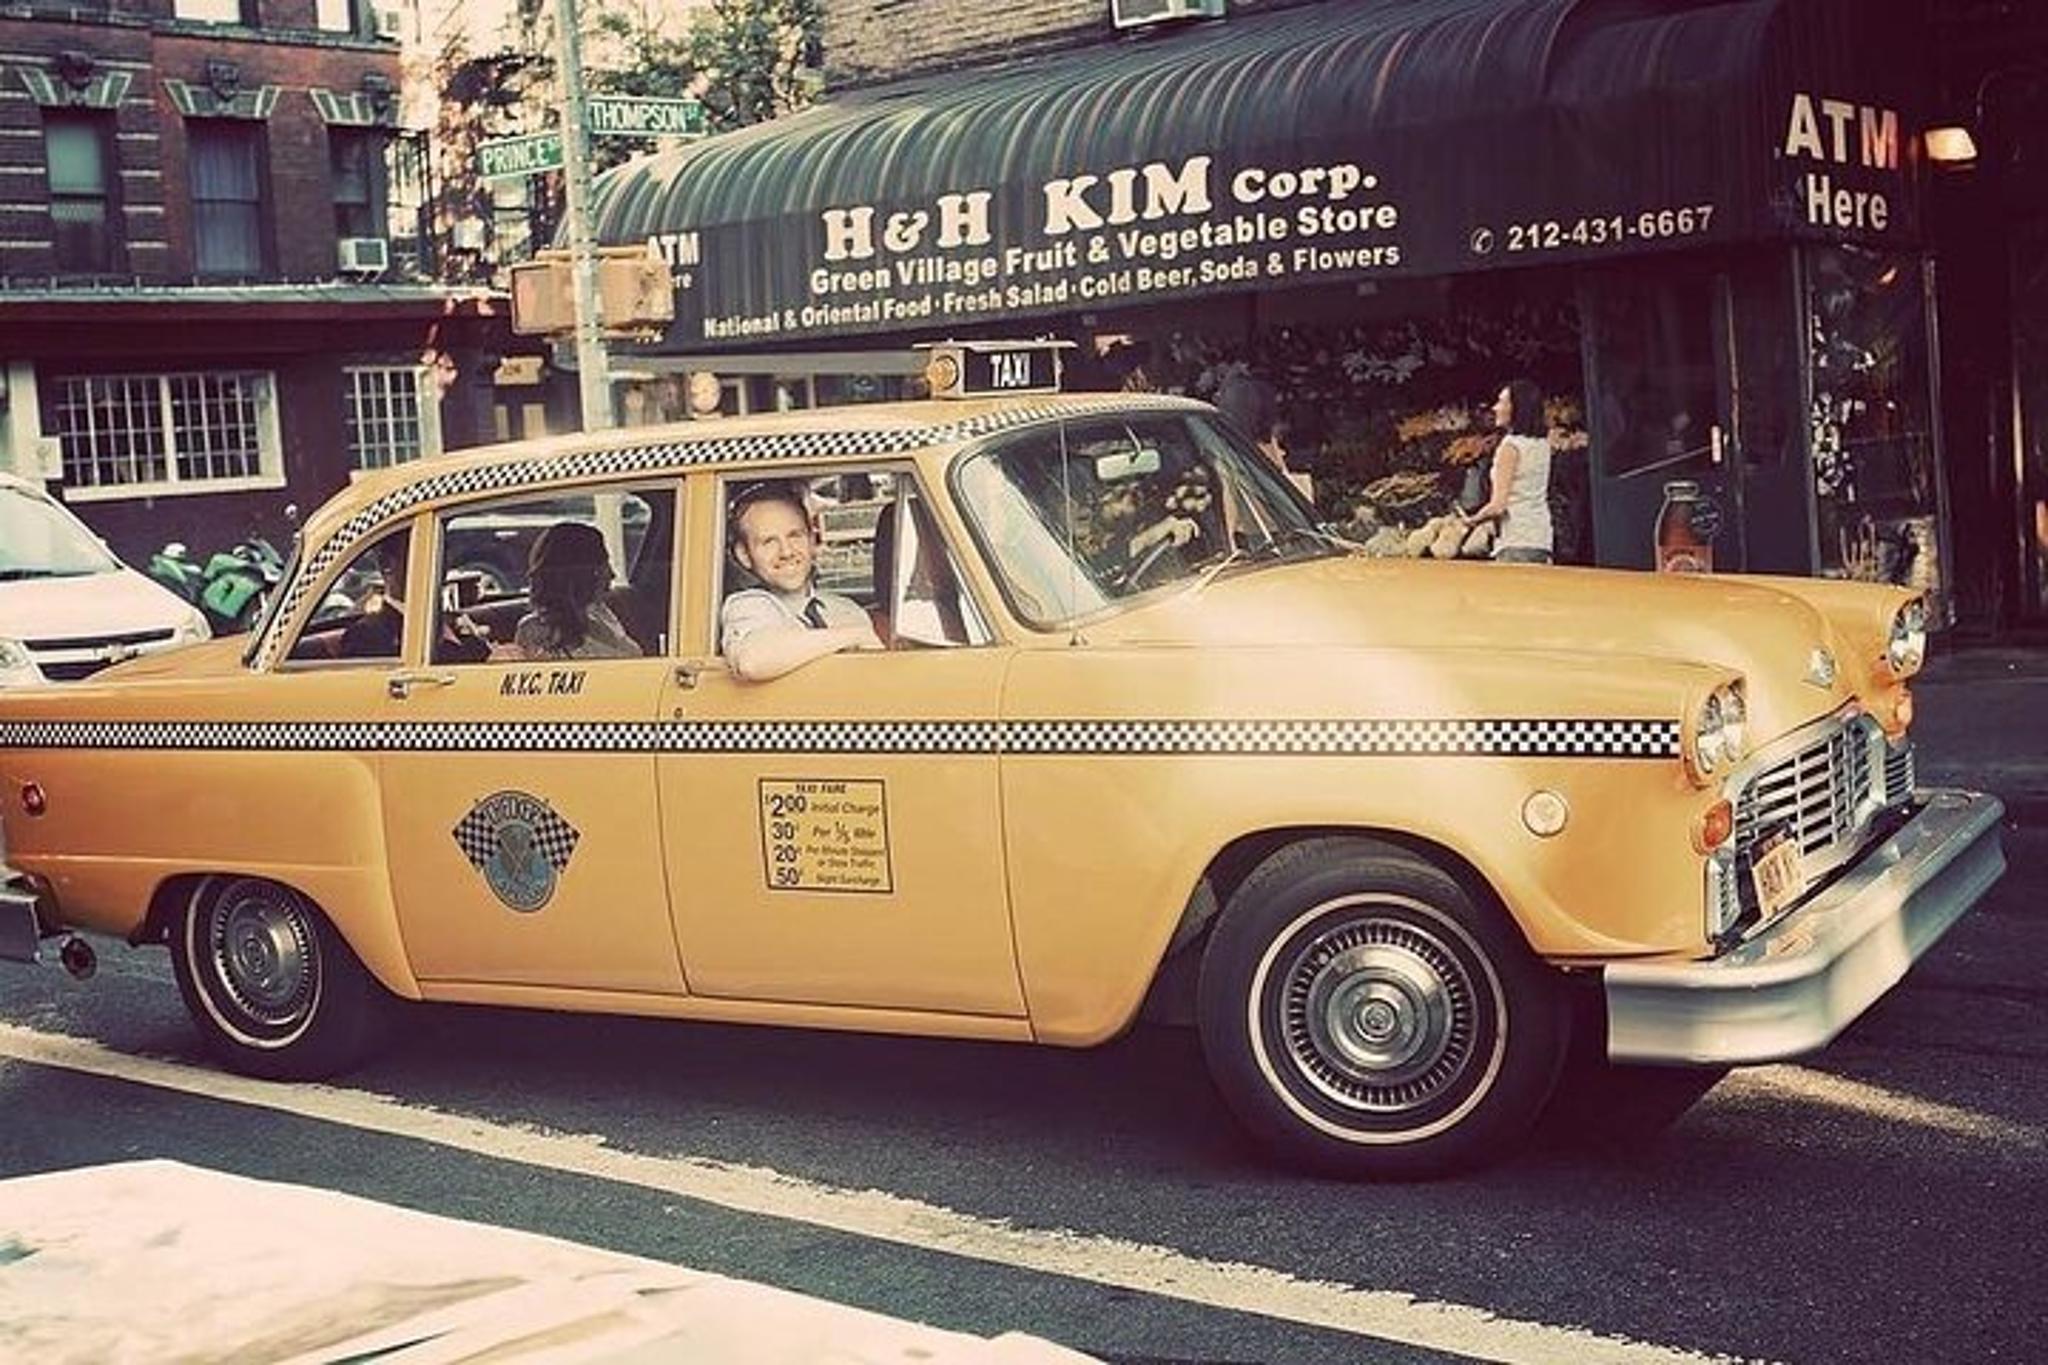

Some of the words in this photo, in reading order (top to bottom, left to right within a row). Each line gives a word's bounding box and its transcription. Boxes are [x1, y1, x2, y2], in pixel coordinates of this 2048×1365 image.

[589, 101, 687, 130] THOMPSON
[1785, 93, 1899, 170] ATM
[482, 138, 548, 175] PRINCE
[1042, 156, 1212, 235] KIM
[1806, 173, 1888, 230] Here
[648, 233, 699, 266] ATM
[811, 268, 891, 295] Green
[895, 255, 998, 287] Village
[1006, 242, 1077, 275] Fruit
[1087, 235, 1111, 264] &
[1118, 212, 1288, 261] Vegetable
[1297, 204, 1398, 236] Store
[1507, 206, 1714, 252] 212-431-6667
[704, 312, 779, 339] National
[784, 308, 798, 328] &
[801, 300, 880, 327] Oriental
[883, 295, 931, 319] Food
[943, 290, 1001, 315] Fresh
[1006, 280, 1068, 308] Salad
[1079, 271, 1131, 297] Cold
[1266, 252, 1284, 275] &
[1293, 245, 1400, 272] Flowers
[989, 352, 1031, 388] TAXI
[500, 673, 542, 696] N.Y.C.
[547, 671, 587, 694] TAXI
